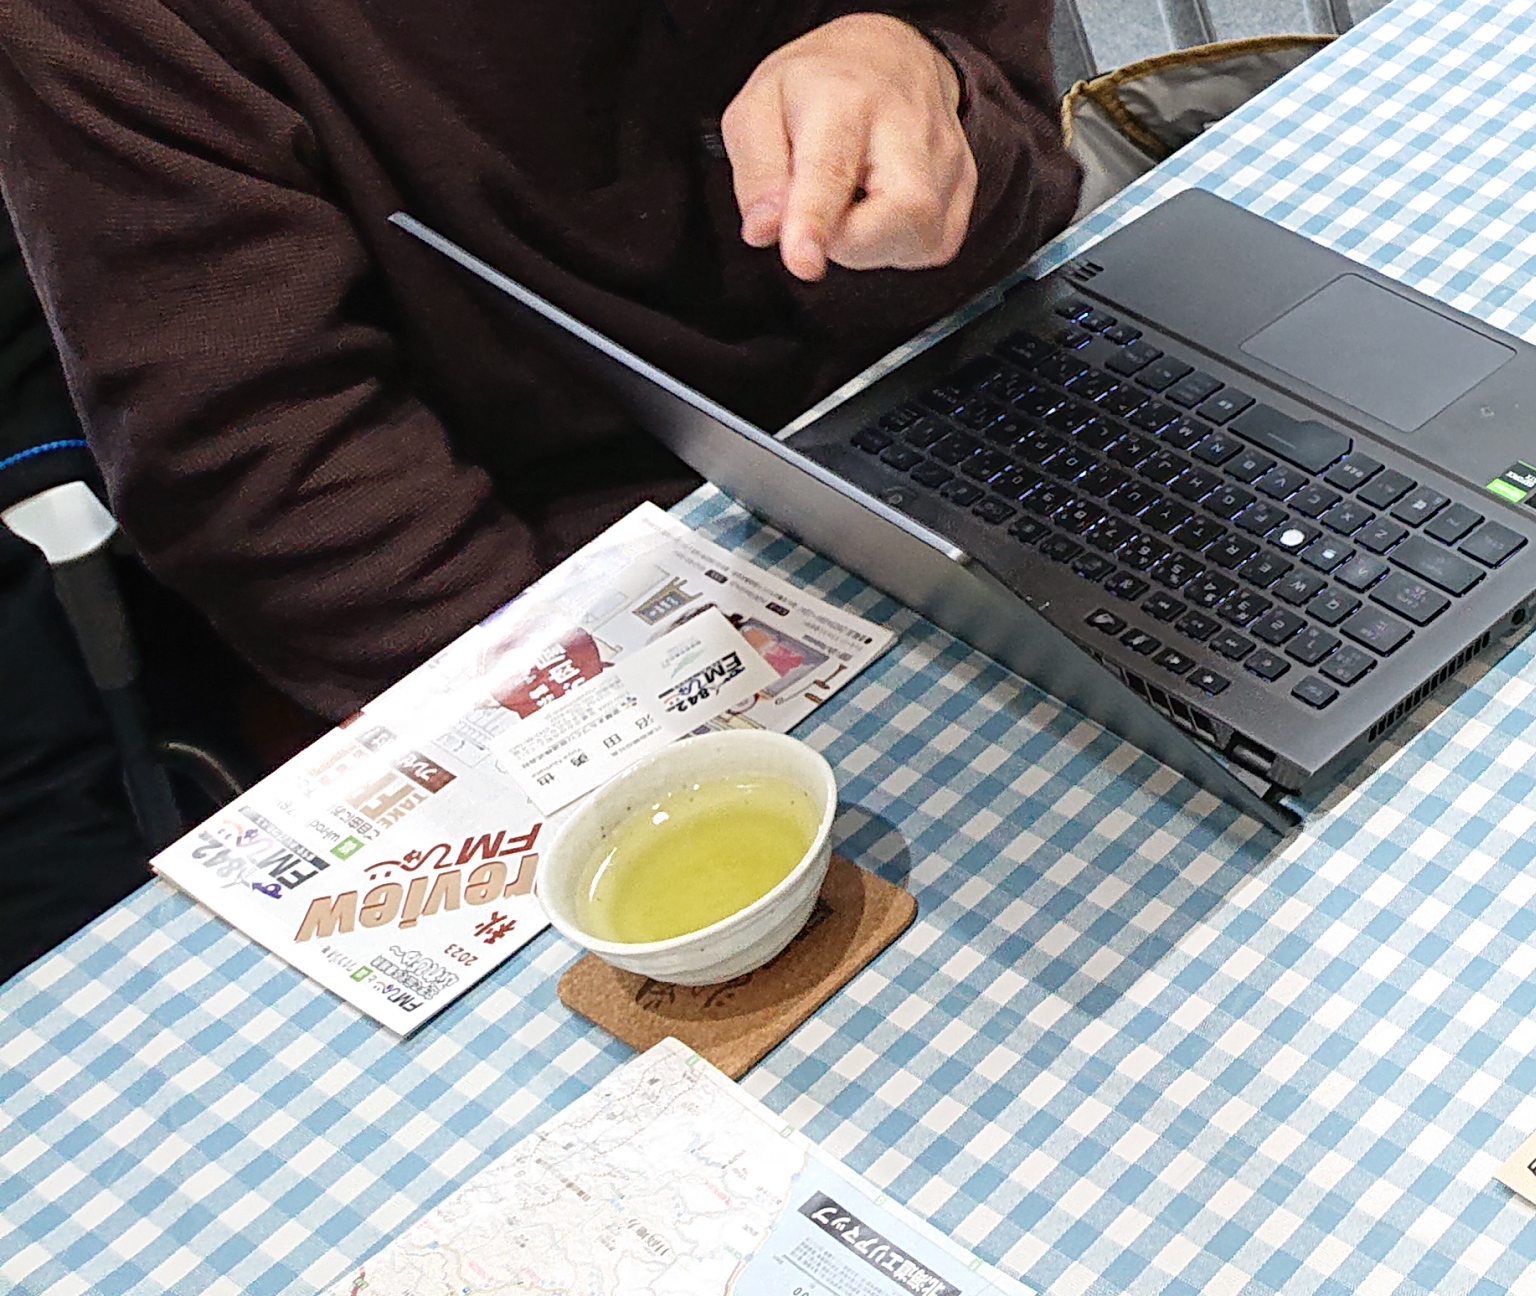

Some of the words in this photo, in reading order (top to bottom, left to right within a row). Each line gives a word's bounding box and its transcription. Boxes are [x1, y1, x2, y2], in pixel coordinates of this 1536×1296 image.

[293, 852, 540, 944] review
[473, 910, 518, 945] 秋
[443, 942, 479, 966] 2023
